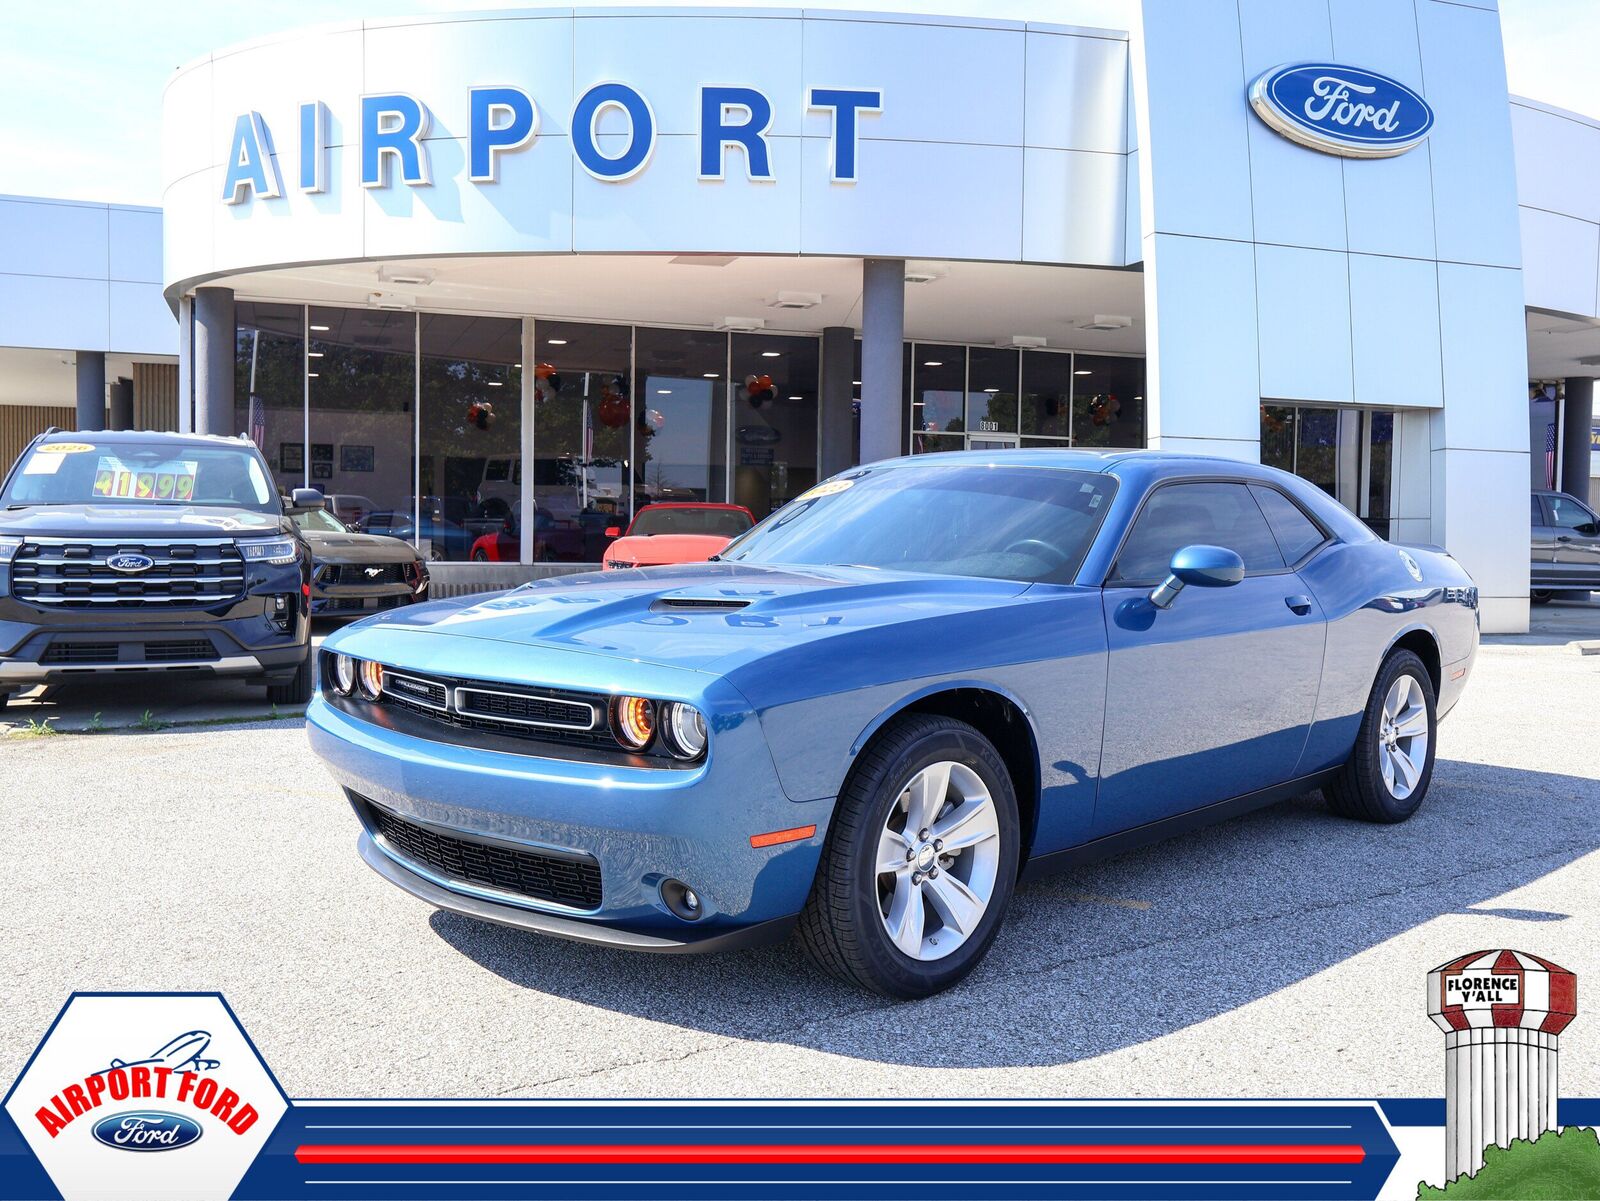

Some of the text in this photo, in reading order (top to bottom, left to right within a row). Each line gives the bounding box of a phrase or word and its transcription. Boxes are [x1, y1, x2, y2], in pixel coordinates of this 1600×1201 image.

[1304, 76, 1401, 133] Ford
[222, 80, 884, 205] AIRPORT
[96, 471, 194, 499] 41999
[117, 557, 143, 568] Ford
[395, 679, 429, 692] CHALLENGER
